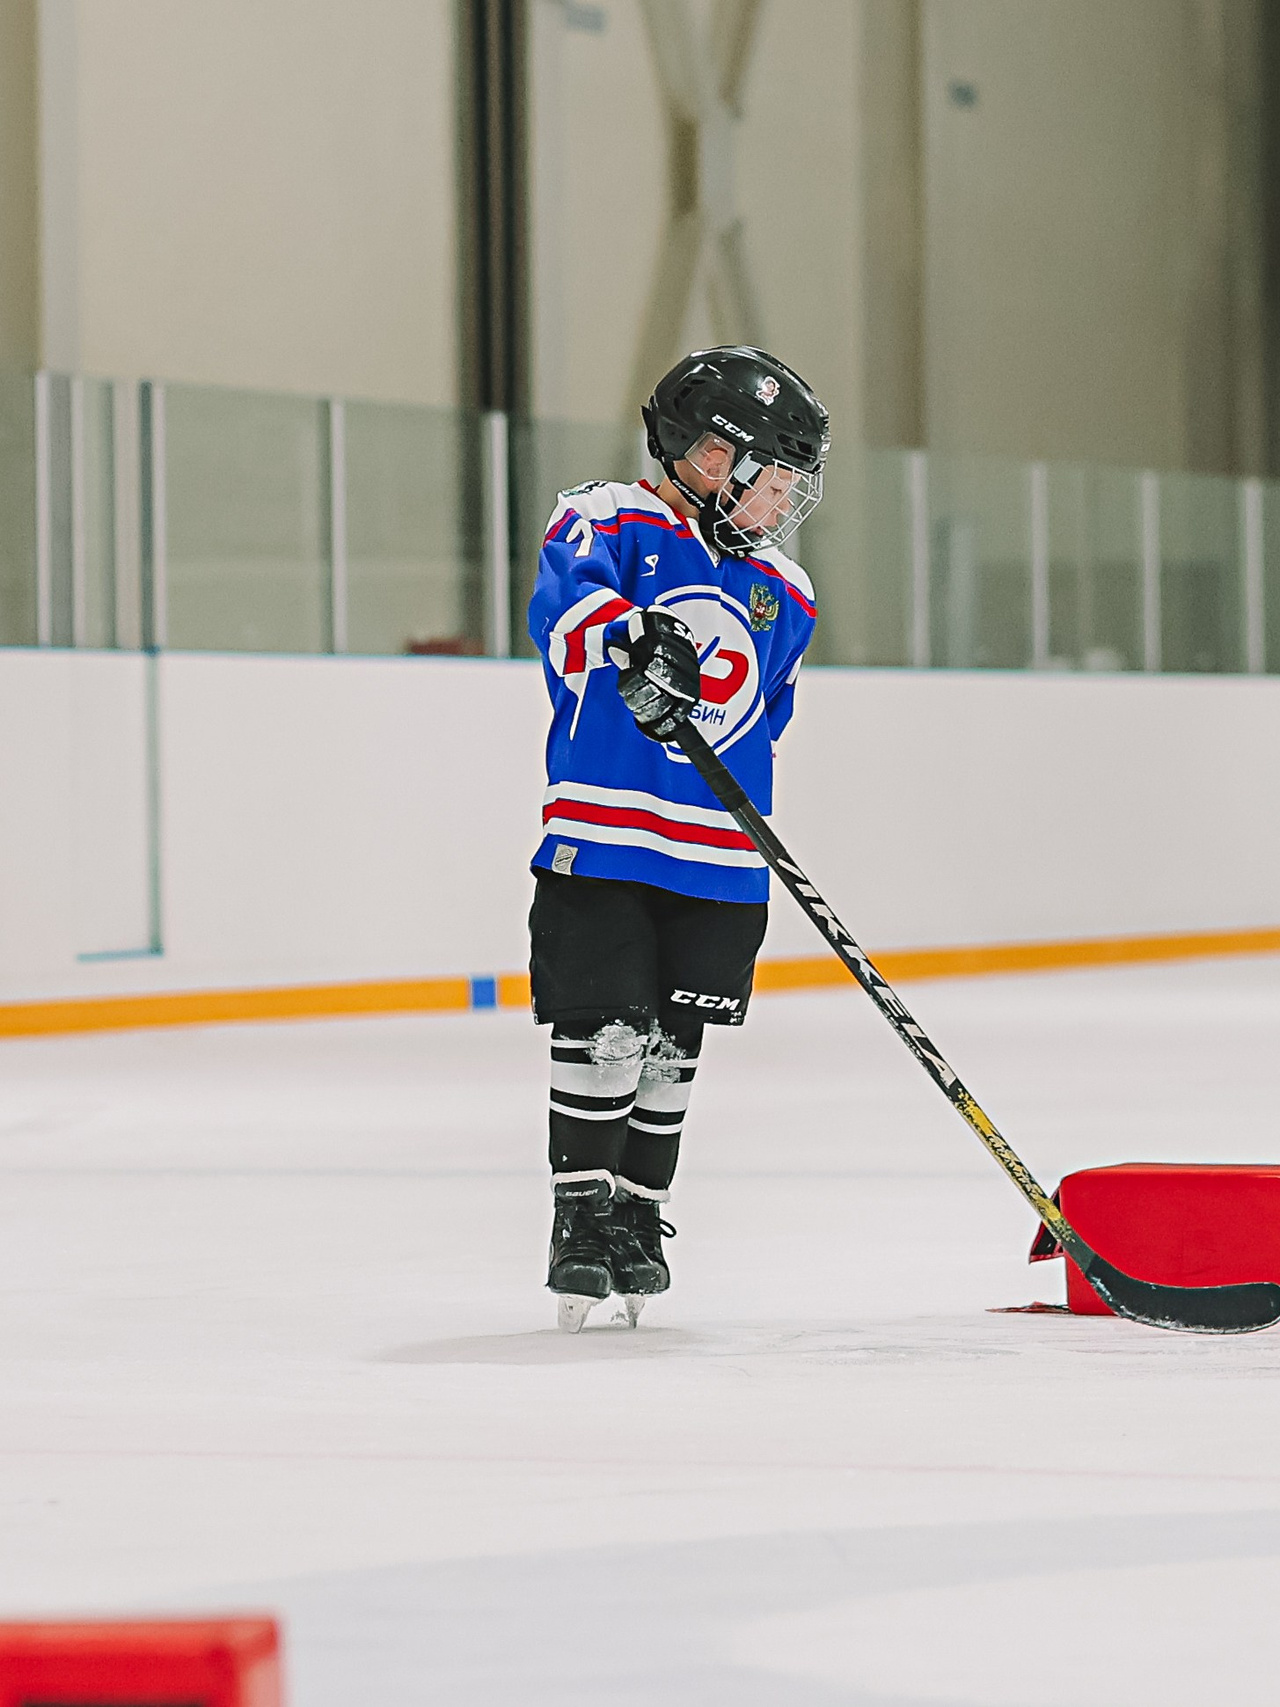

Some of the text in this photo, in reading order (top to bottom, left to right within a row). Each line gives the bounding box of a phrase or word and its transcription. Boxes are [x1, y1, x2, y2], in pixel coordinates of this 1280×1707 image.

[712, 413, 755, 442] CCM
[672, 479, 706, 508] BAUER
[690, 704, 726, 725] БИН
[670, 989, 740, 1011] CCM
[565, 1188, 599, 1197] BAUER
